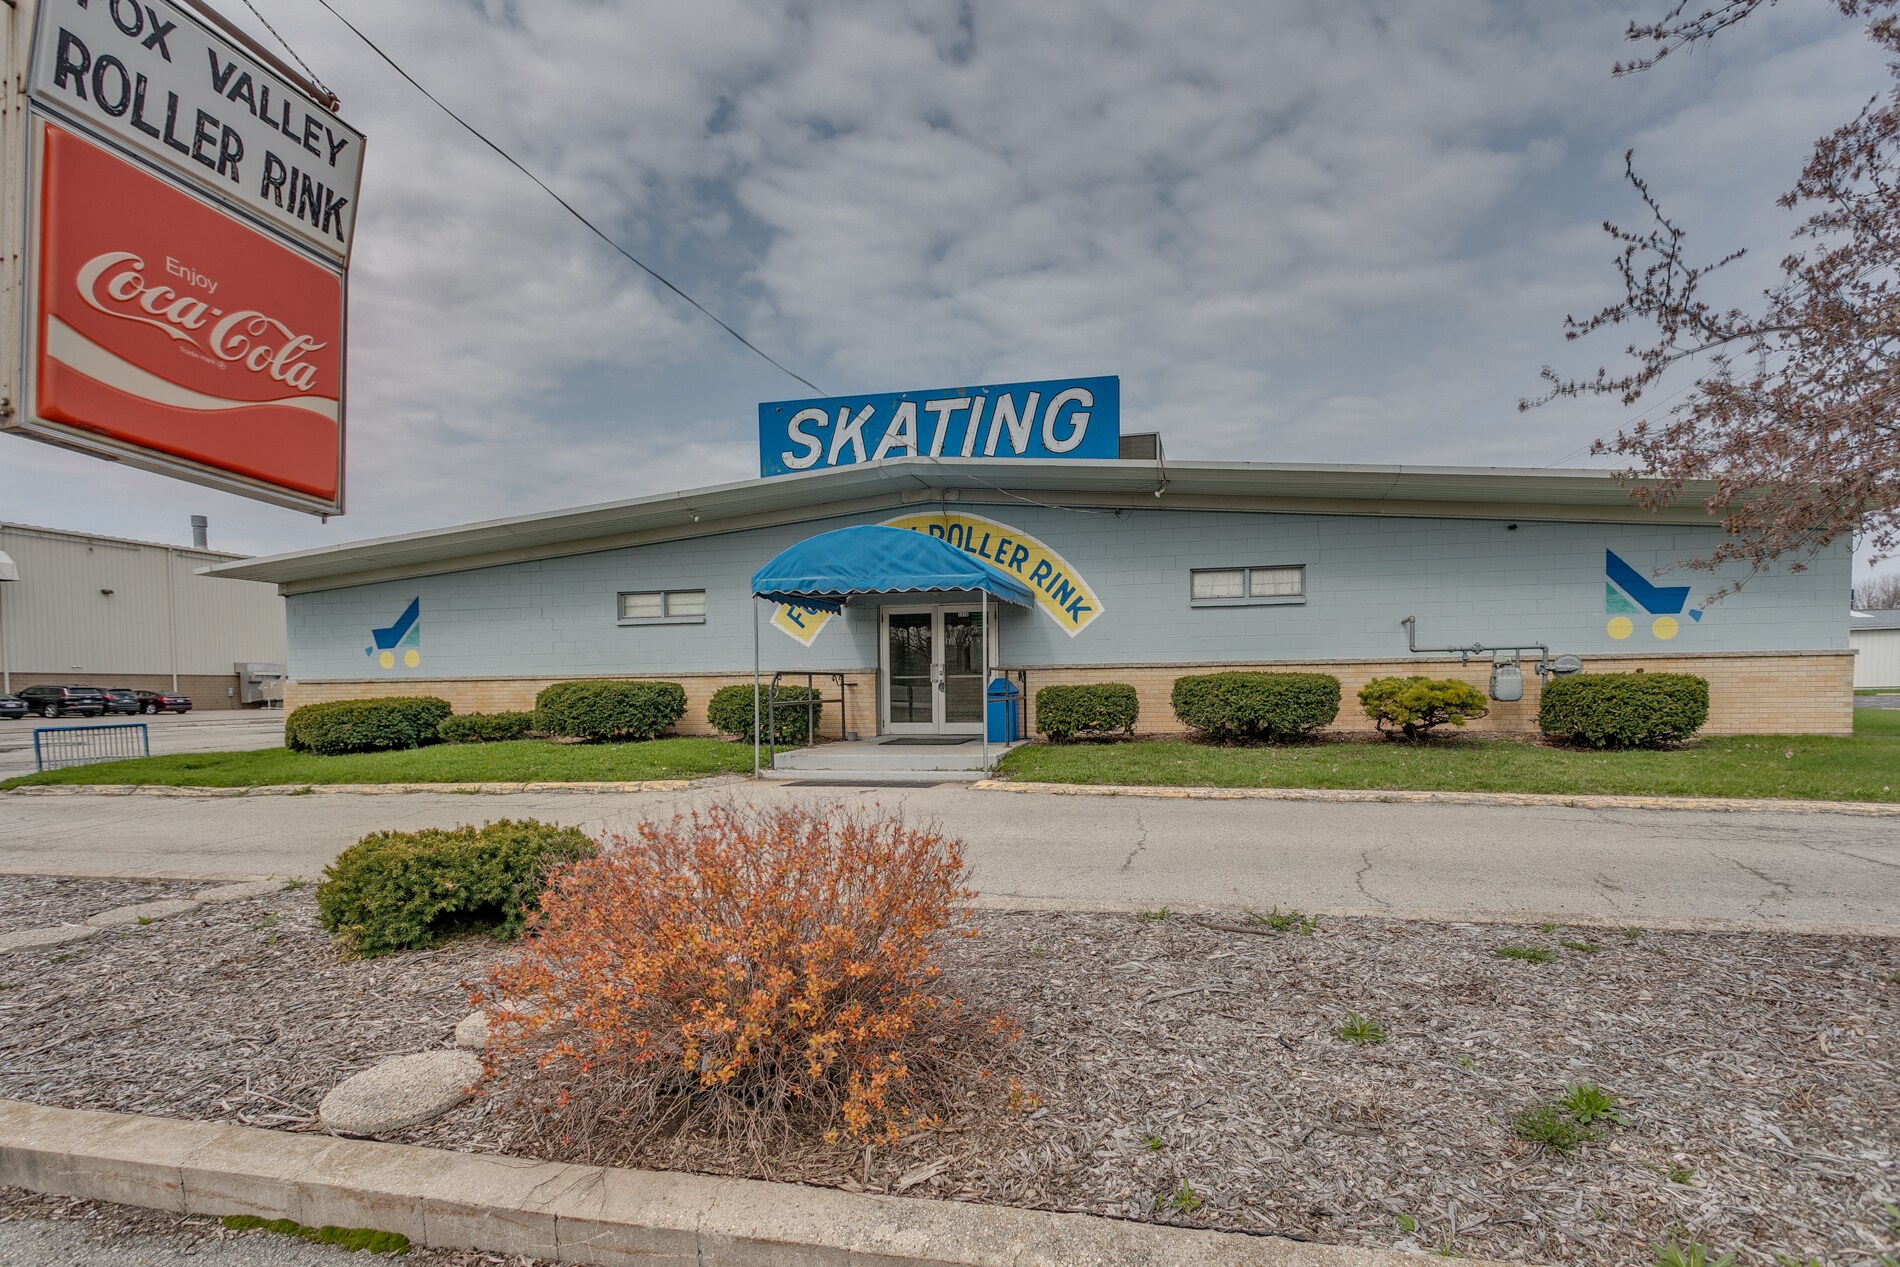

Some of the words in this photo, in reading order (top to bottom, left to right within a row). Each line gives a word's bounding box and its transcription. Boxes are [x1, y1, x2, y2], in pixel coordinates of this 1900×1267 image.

[54, 26, 244, 183] ROLLER
[260, 150, 349, 243] RINK
[77, 0, 177, 63] OX
[207, 47, 349, 168] VALLEY
[76, 251, 328, 391] Coca-Cola
[166, 255, 218, 294] Enjoy
[781, 387, 1094, 470] SKATING
[1029, 558, 1093, 625] RINK
